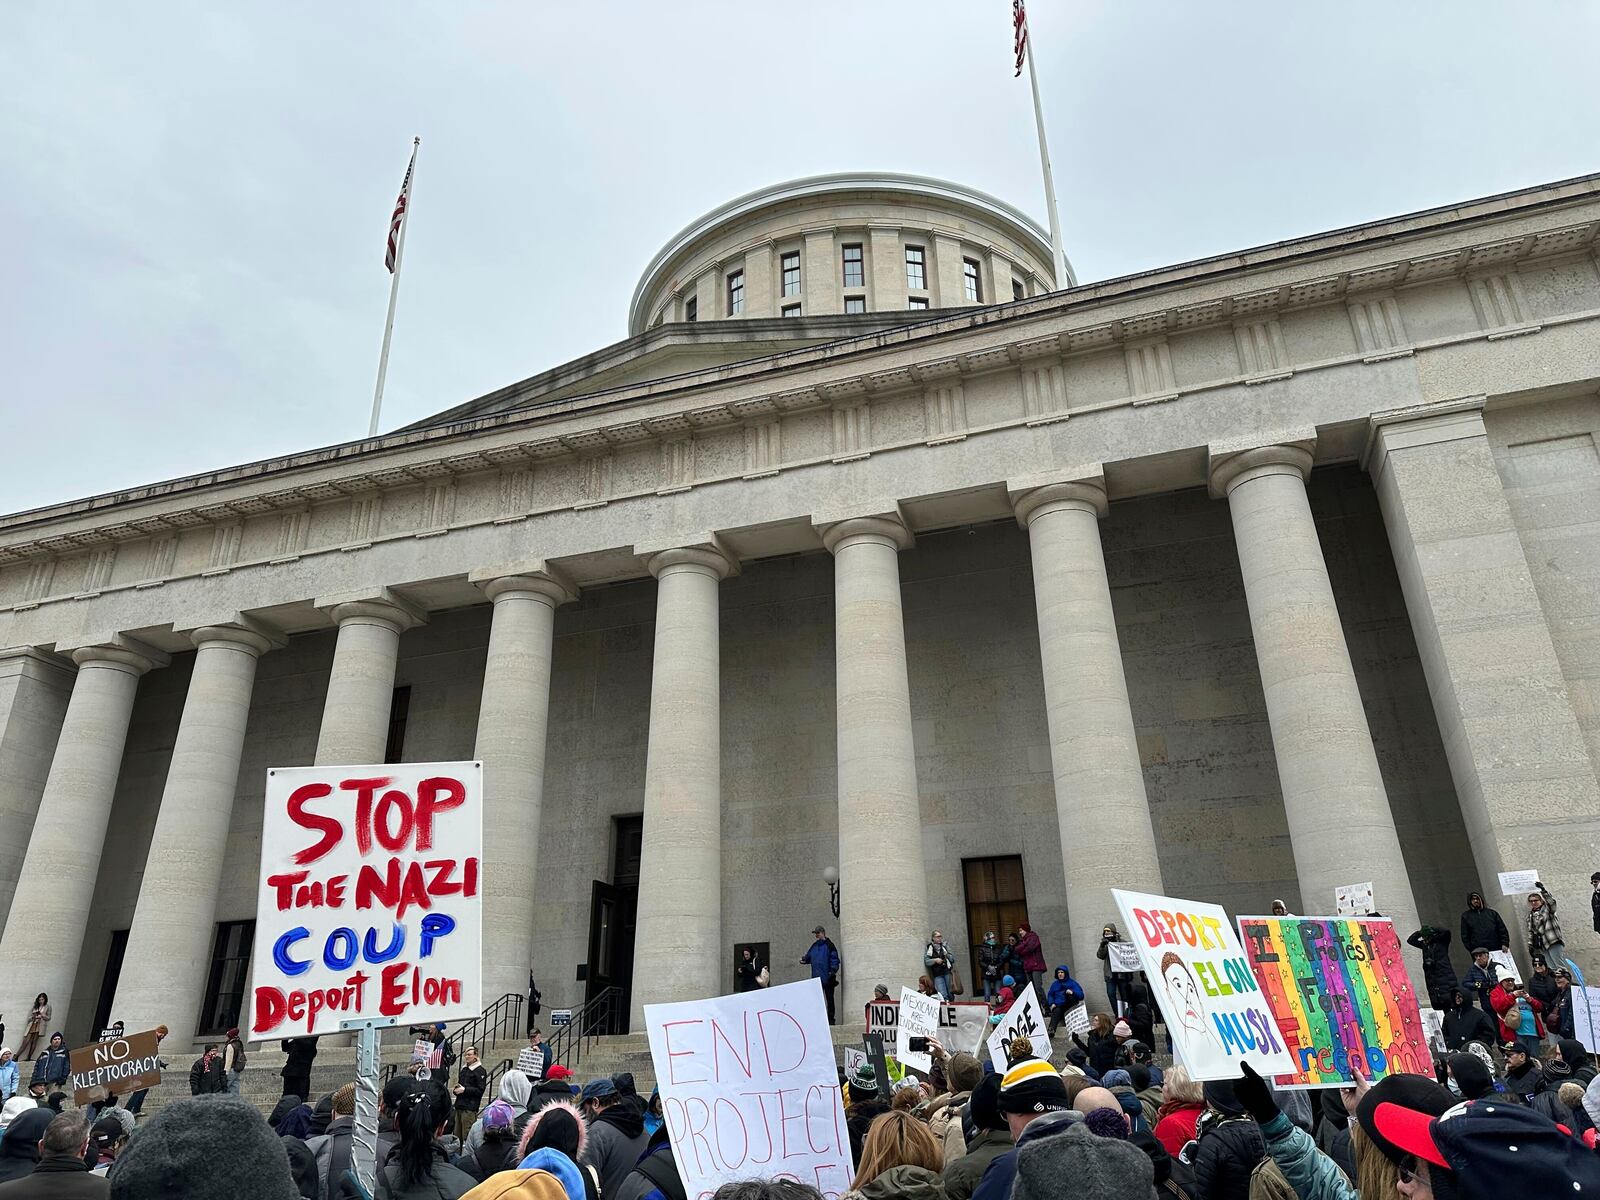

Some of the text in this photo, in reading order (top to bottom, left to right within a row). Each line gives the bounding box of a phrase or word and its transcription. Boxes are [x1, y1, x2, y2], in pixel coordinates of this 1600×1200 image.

[287, 776, 466, 865] STOP
[267, 857, 478, 921] THE NAZI
[273, 913, 456, 976] COUP
[1133, 908, 1227, 951] DEPORT
[1245, 920, 1376, 963] I Protest
[252, 962, 461, 1034] Deport Elon
[1192, 957, 1258, 997] ELON
[1297, 977, 1349, 1014] For
[903, 993, 939, 1019] MEXICANS
[93, 1040, 130, 1065] NO
[662, 1009, 807, 1085] END
[1211, 1007, 1282, 1056] MUSK
[1276, 1017, 1423, 1075] Freedom
[72, 1054, 159, 1091] KLEPTOCRACY
[664, 1085, 843, 1183] PROJECT
